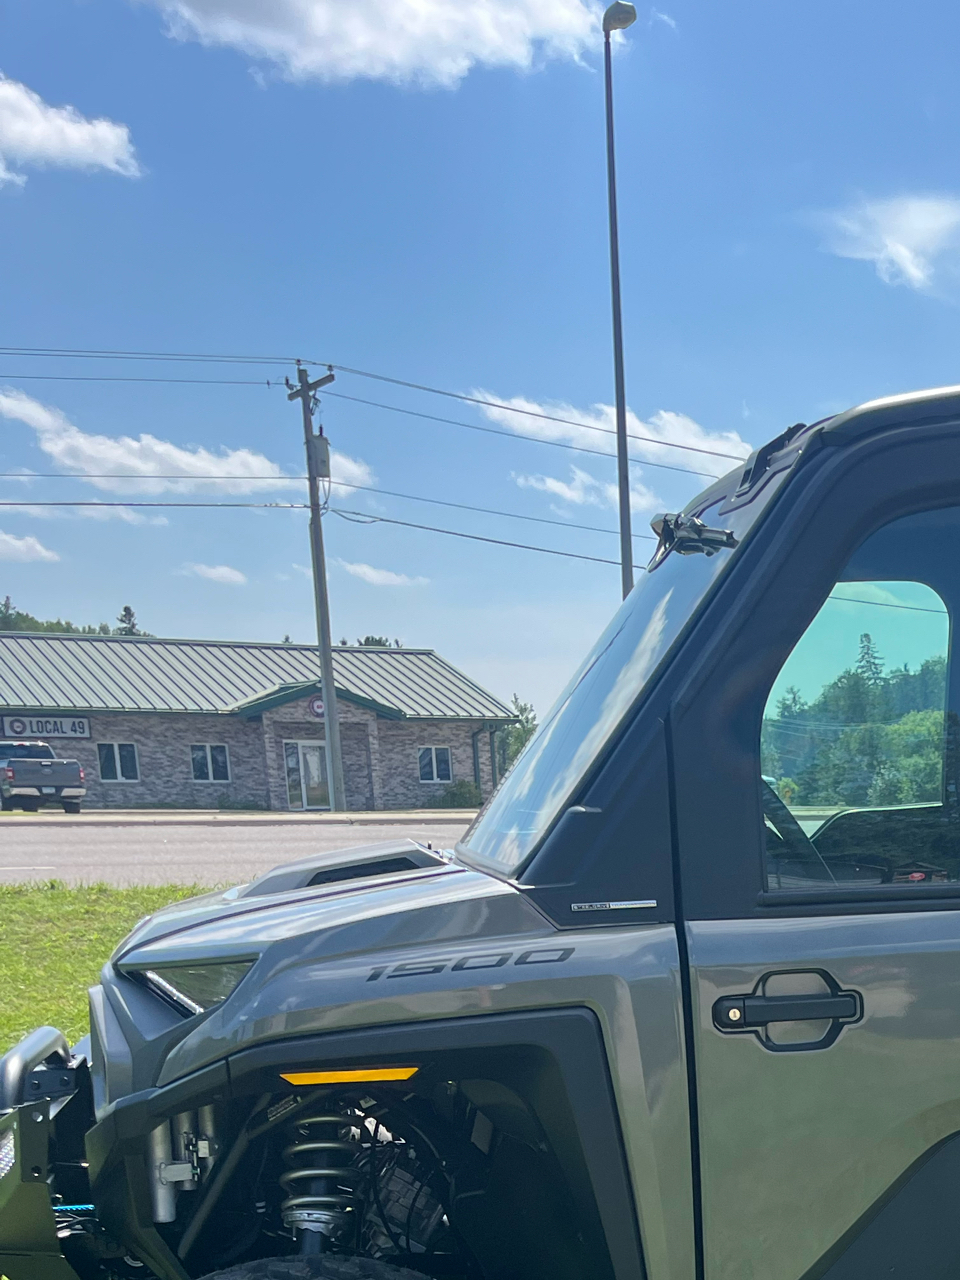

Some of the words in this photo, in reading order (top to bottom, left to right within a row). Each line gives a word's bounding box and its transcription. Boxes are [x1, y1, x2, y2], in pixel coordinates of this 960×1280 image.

[29, 720, 67, 734] LOCAL
[70, 720, 85, 734] 49
[365, 947, 576, 982] 1500
